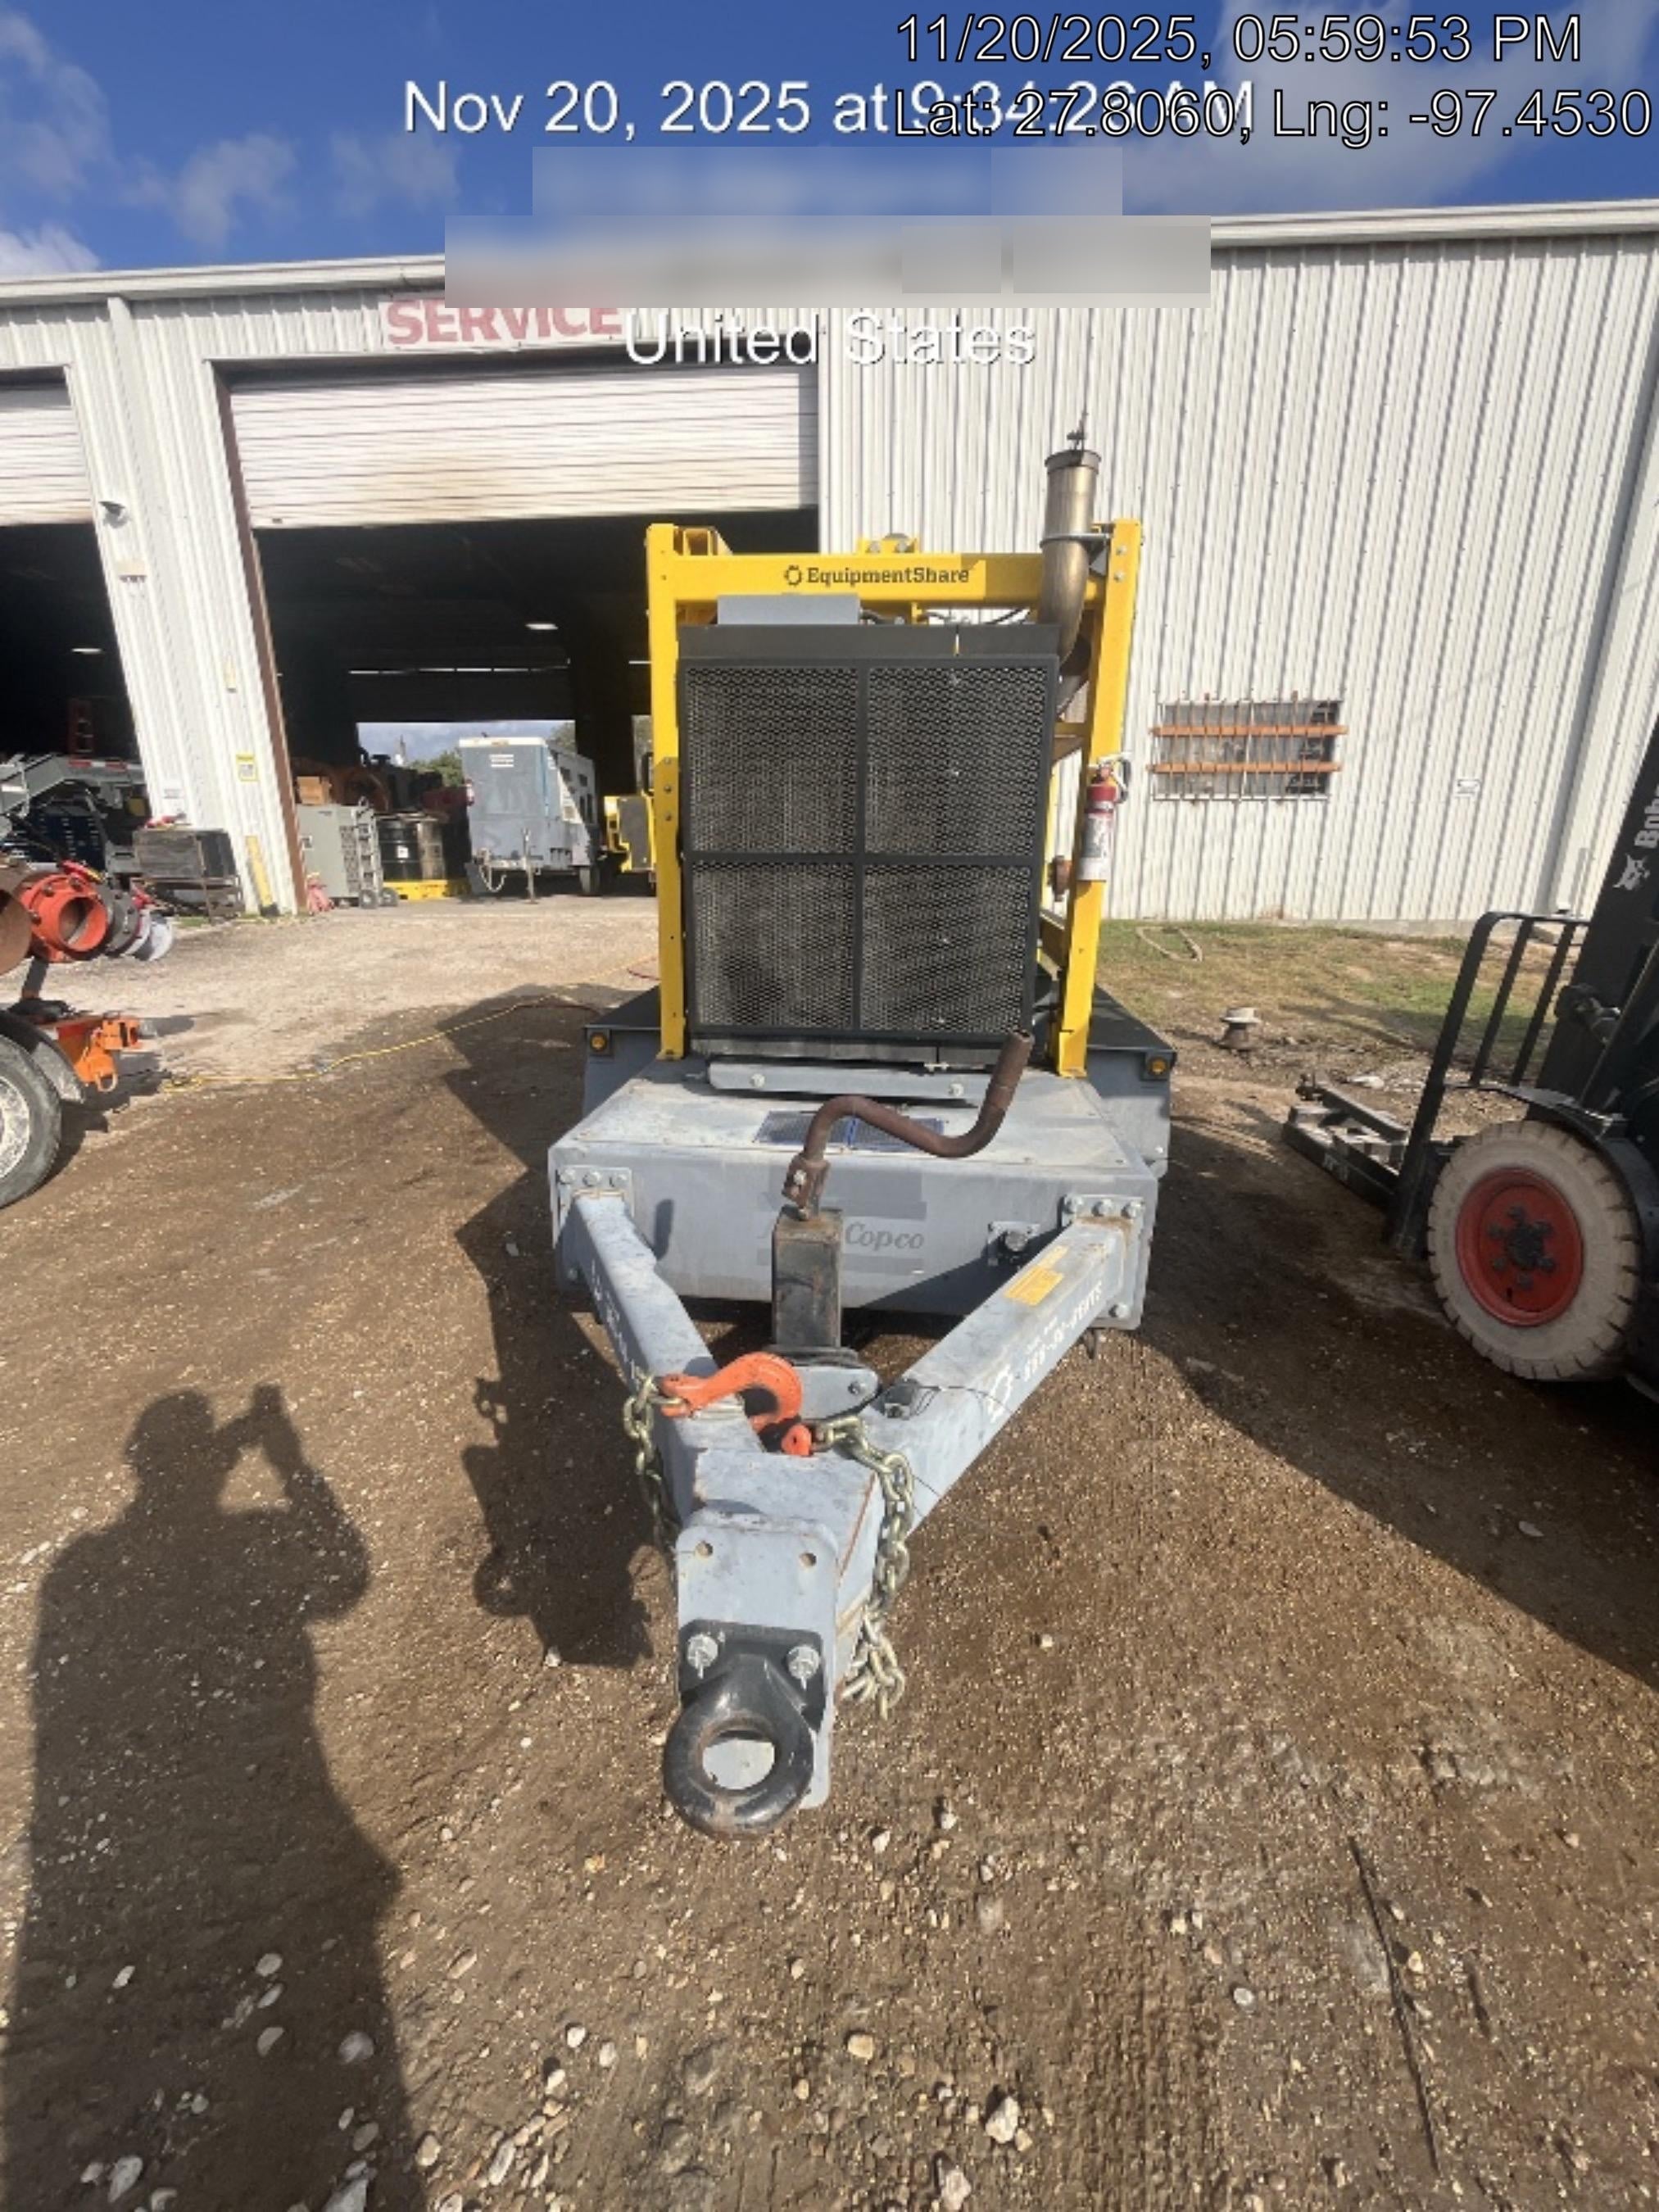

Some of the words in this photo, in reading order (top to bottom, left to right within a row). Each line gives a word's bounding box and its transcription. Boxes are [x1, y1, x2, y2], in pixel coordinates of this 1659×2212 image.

[388, 300, 623, 345] SERVICE
[806, 566, 970, 587] EquipmentShare
[845, 1221, 925, 1252] Copco
